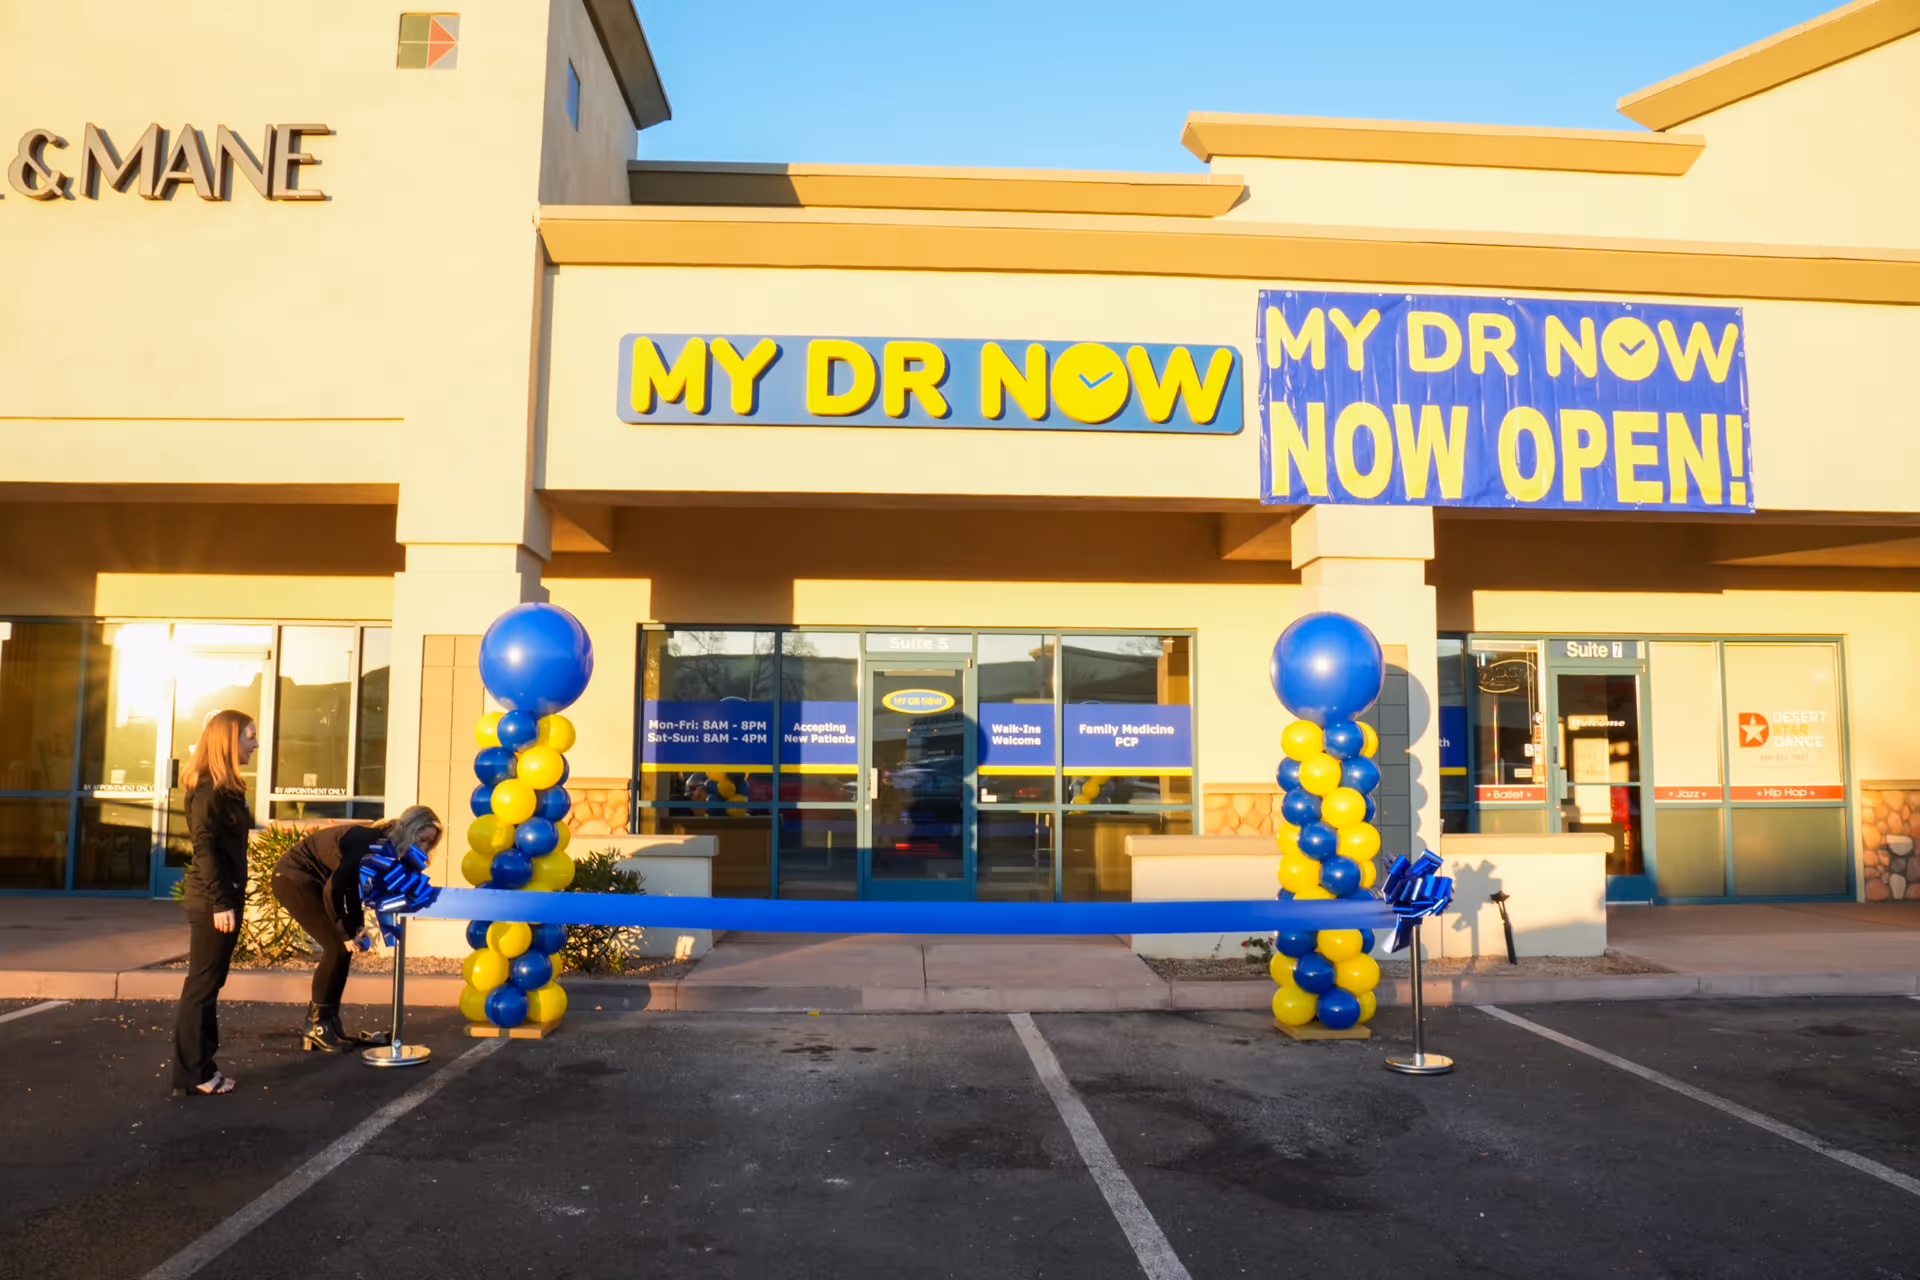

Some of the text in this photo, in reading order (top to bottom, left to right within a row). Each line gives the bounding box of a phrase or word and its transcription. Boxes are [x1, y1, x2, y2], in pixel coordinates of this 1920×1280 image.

[8, 122, 335, 201] & MANE
[1265, 306, 1738, 383] MY DR NOW
[630, 336, 1235, 424] MY DR NOW
[1270, 401, 1746, 505] NOW OPEN!
[889, 637, 950, 650] Suite 5
[1566, 641, 1609, 658] Suite
[893, 697, 943, 706] MY DR NOW
[1773, 711, 1828, 722] DESERT
[649, 720, 699, 731] Mon-Fri:
[702, 721, 729, 731] 8AM
[741, 722, 767, 732] 8PM
[793, 723, 846, 734] Accepting
[1571, 719, 1626, 727] Welcome
[992, 724, 1041, 734] Walk-Ins
[1079, 724, 1175, 737] Family Medicine
[1773, 723, 1809, 735] STAR
[647, 733, 699, 743] Sat-Sun:
[702, 734, 729, 744] 8AM
[742, 734, 767, 744] 4PM
[784, 734, 855, 744] New Patients
[992, 736, 1041, 745] Welcome
[1115, 737, 1139, 747] PCP
[1774, 736, 1824, 748] DANCE
[284, 787, 327, 795] APPOINTMENT
[328, 788, 346, 796] ONLY
[1493, 790, 1523, 799] Ballet
[1675, 790, 1699, 798] Jazz
[1764, 788, 1807, 797] Hip Hop
